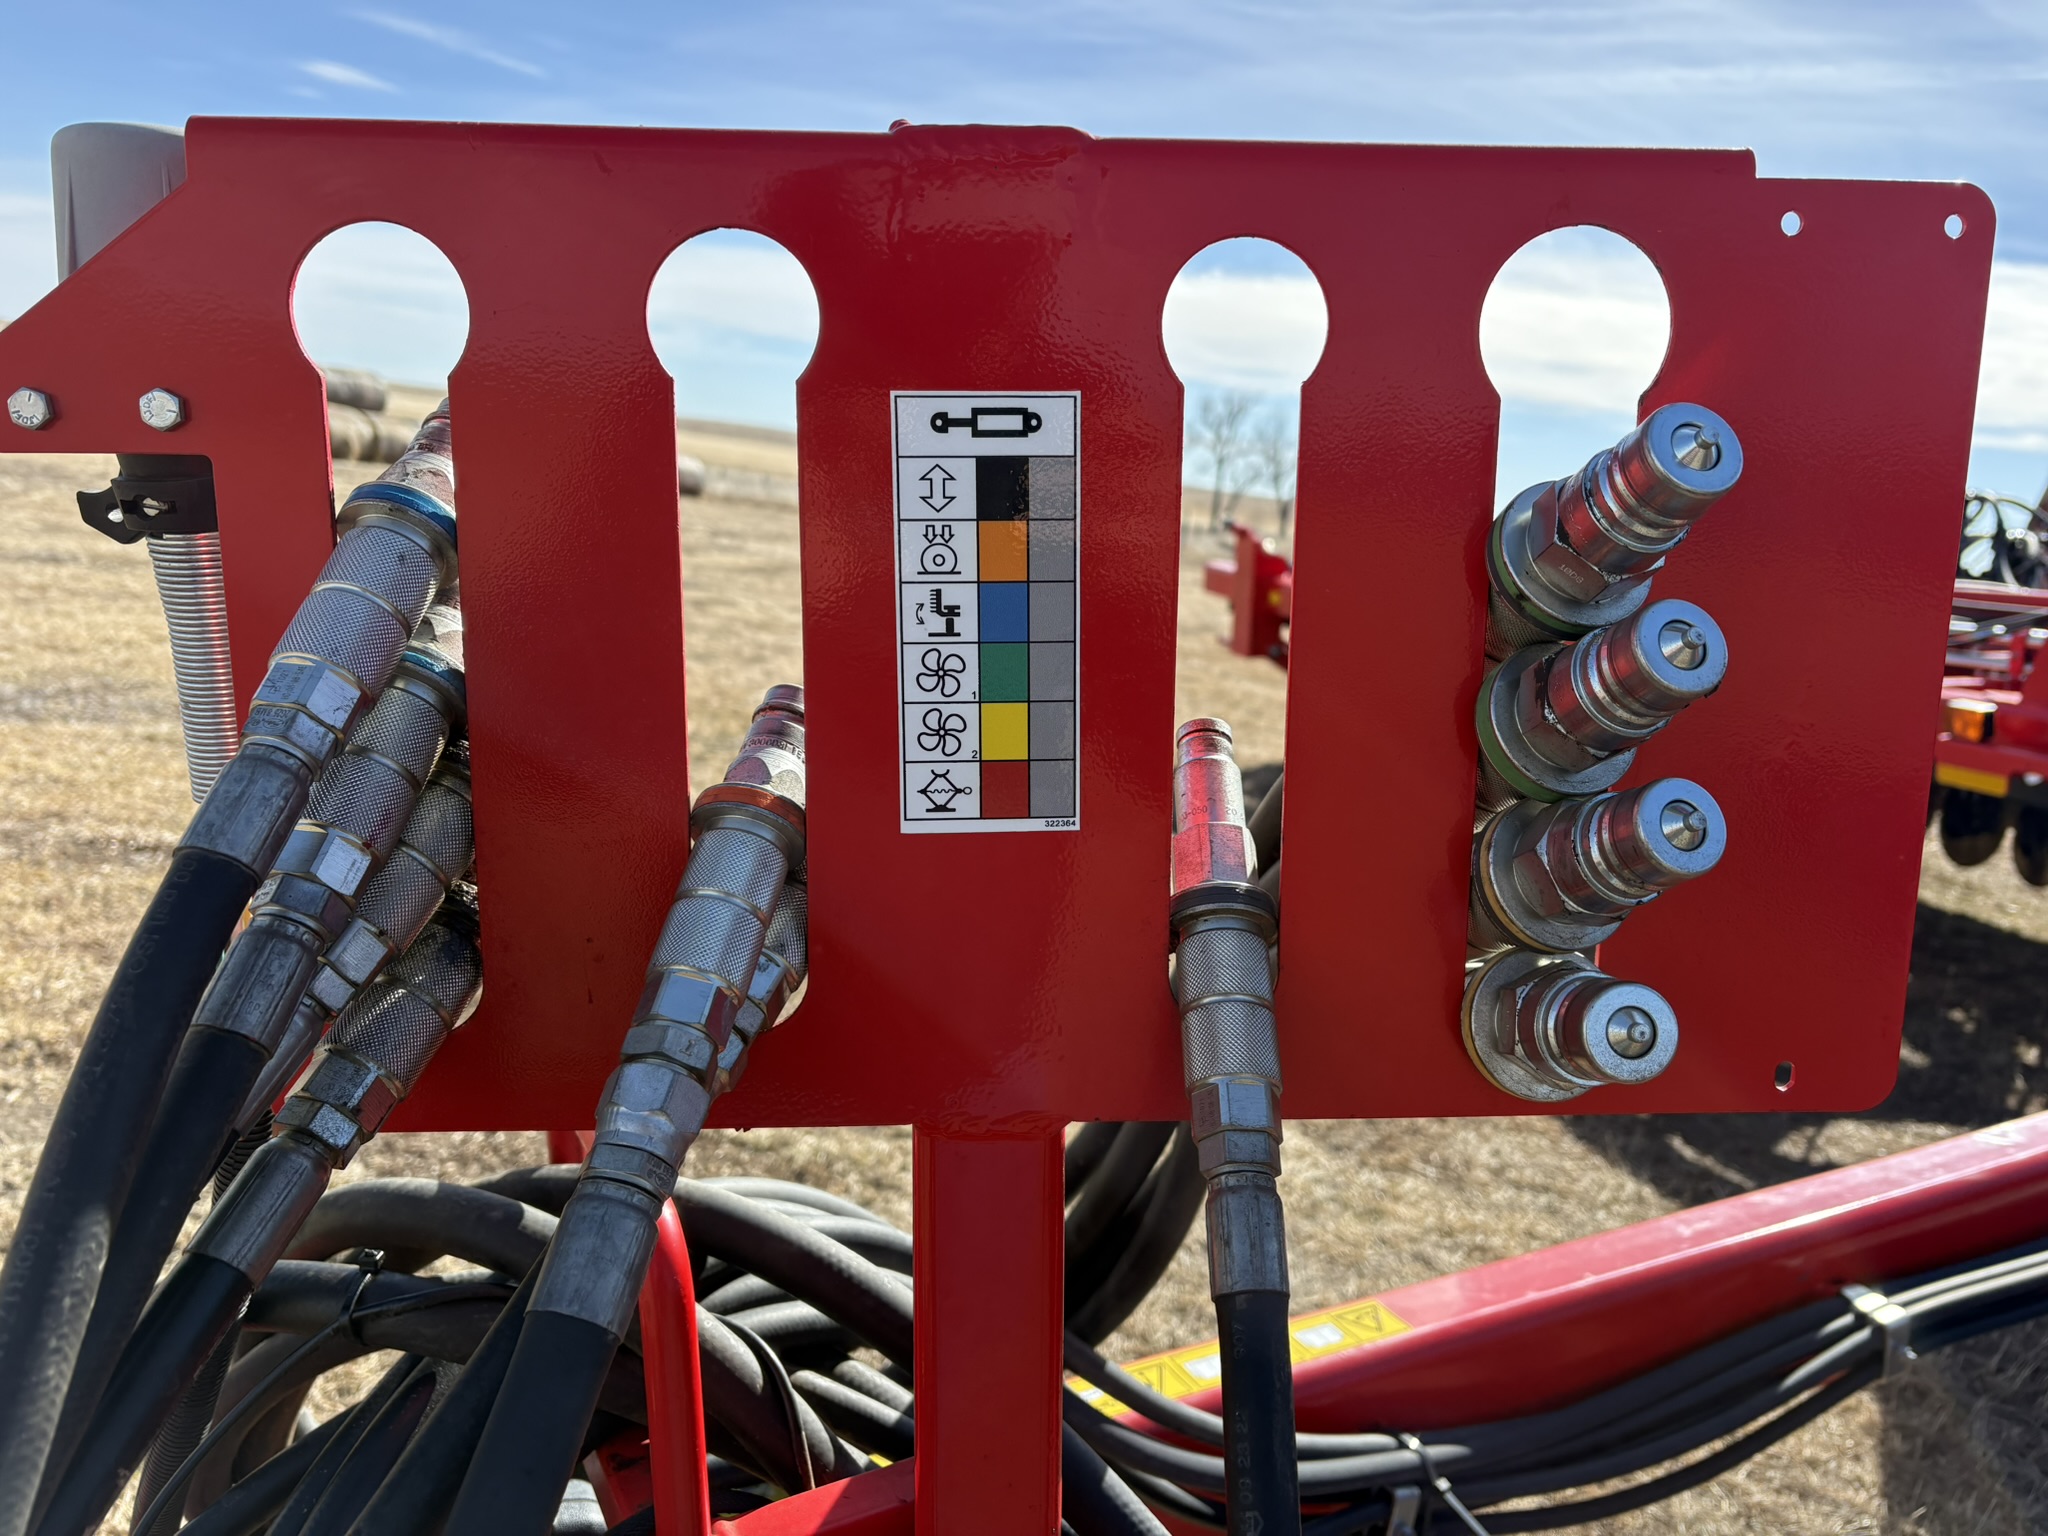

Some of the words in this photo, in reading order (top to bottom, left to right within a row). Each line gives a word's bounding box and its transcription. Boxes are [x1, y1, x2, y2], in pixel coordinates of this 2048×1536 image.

[971, 690, 976, 700] 1
[971, 749, 978, 759] 2
[1044, 819, 1076, 828] 322364
